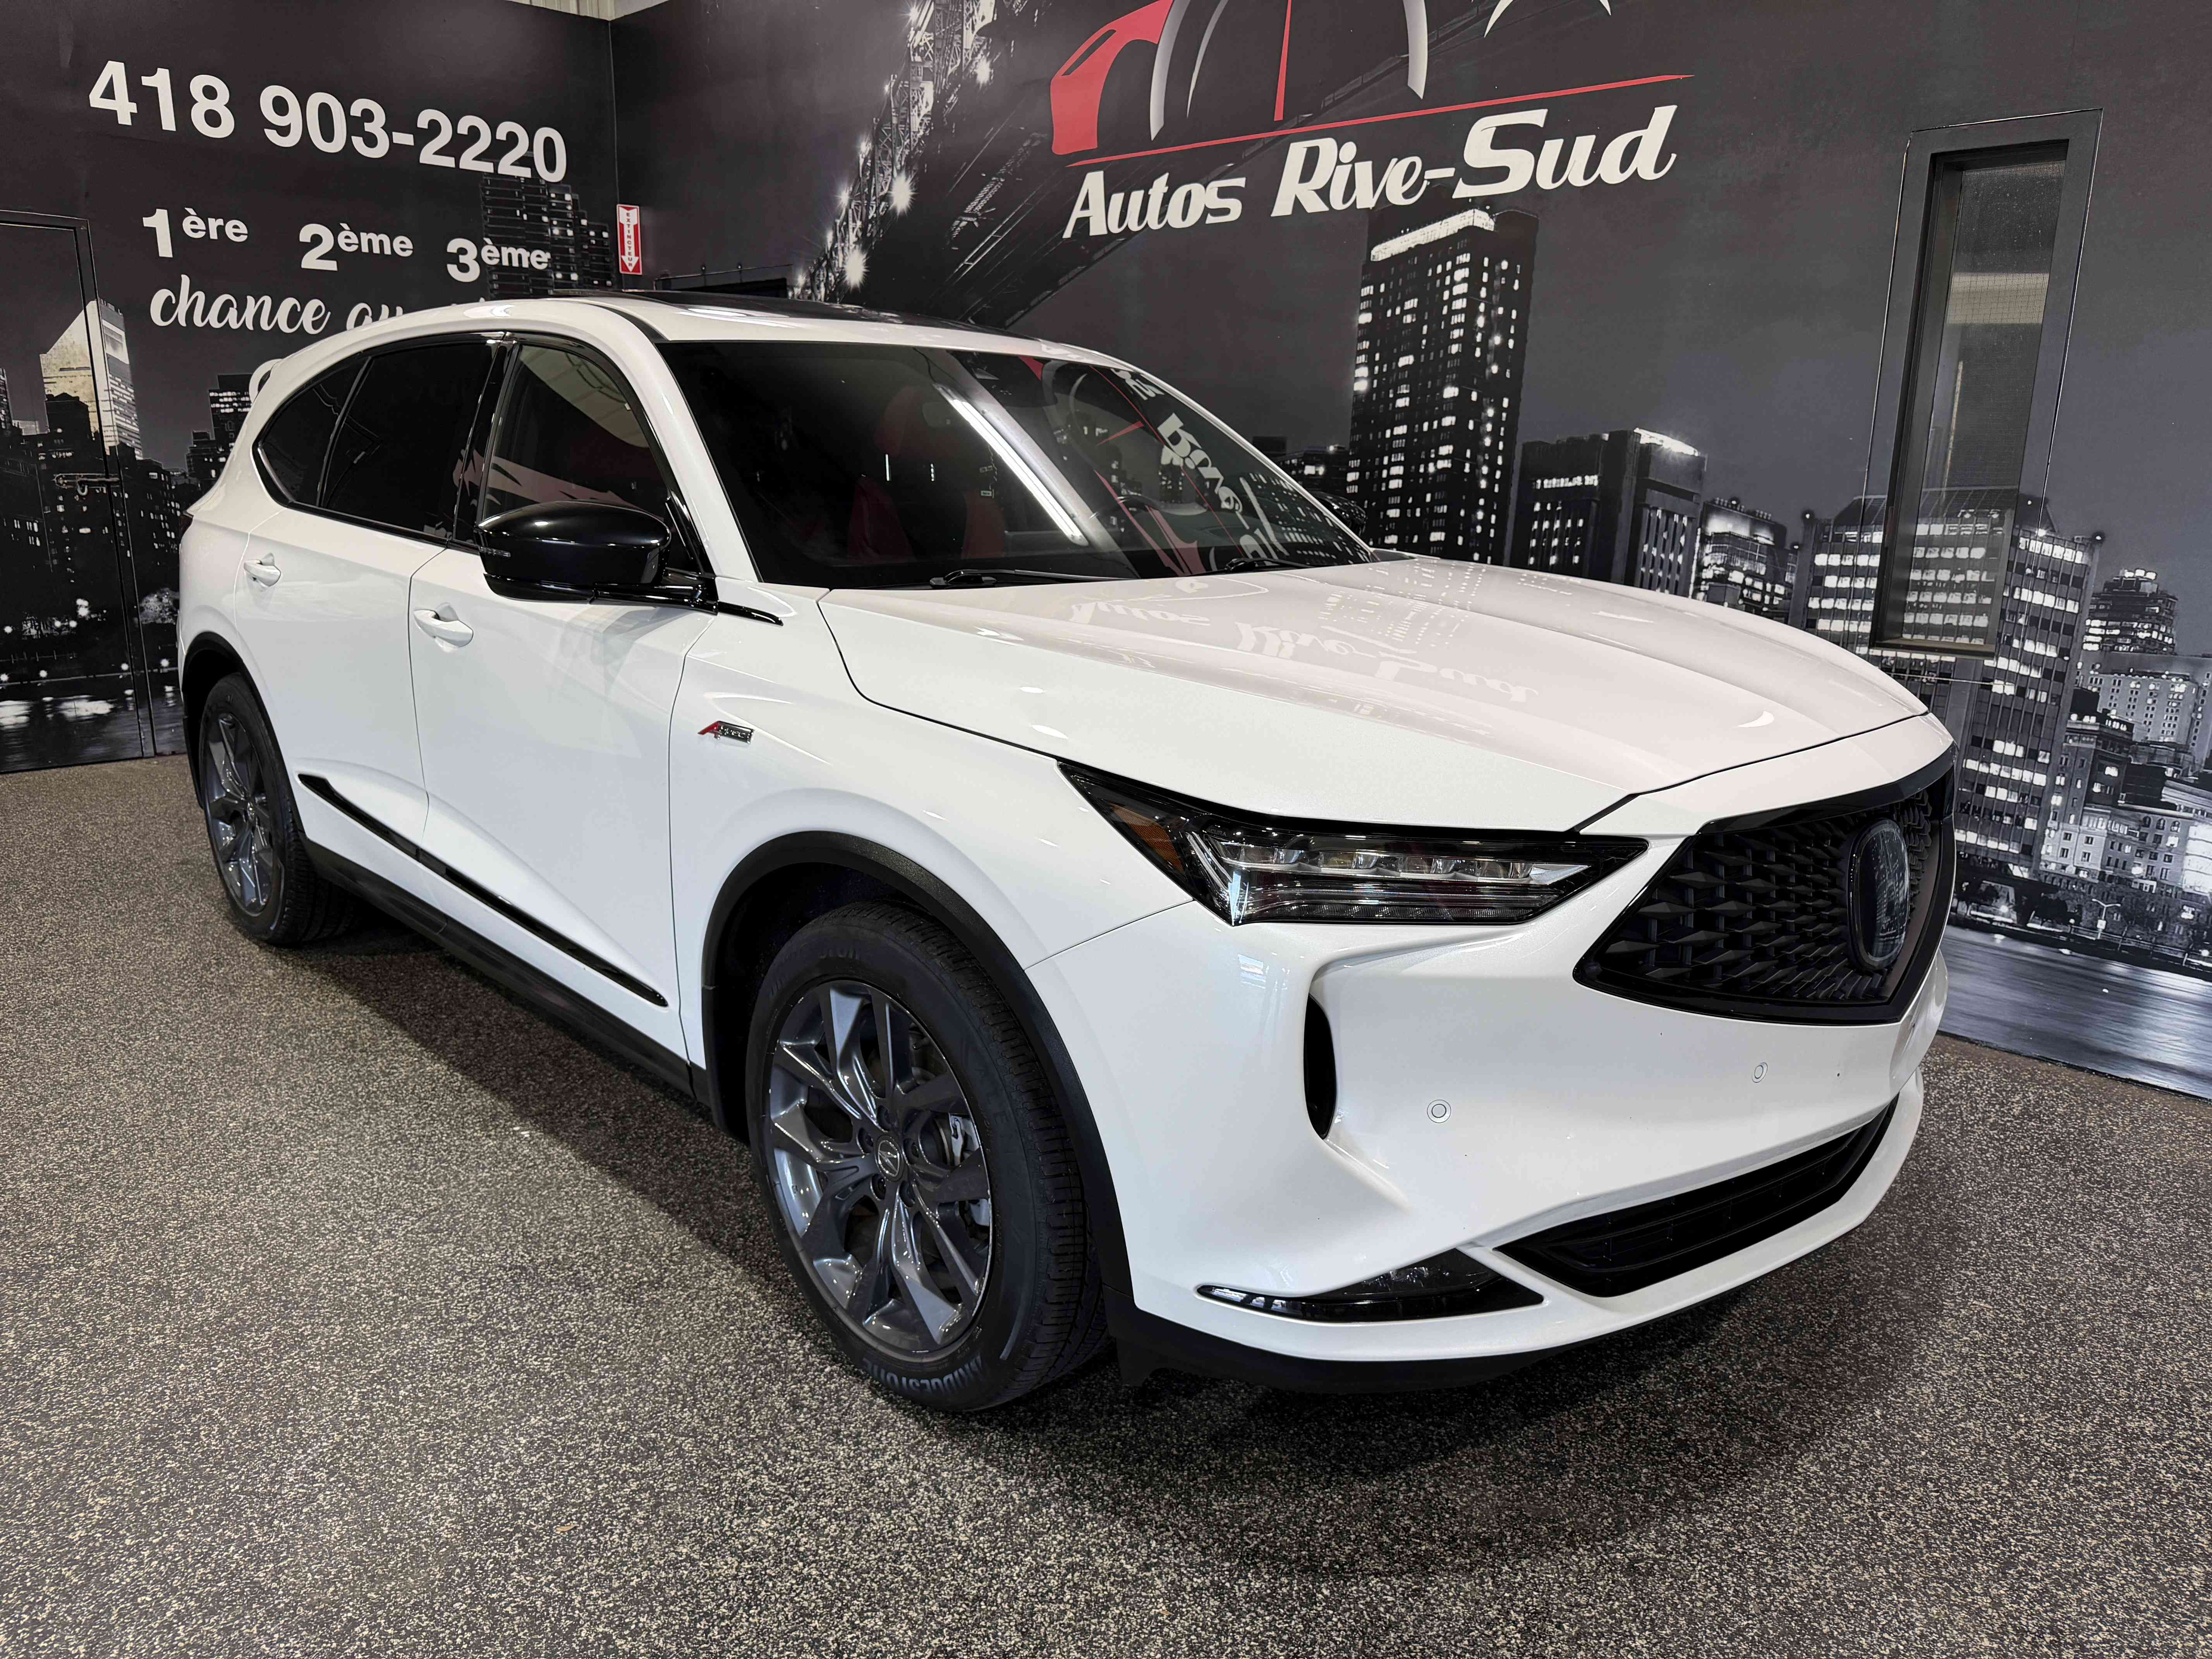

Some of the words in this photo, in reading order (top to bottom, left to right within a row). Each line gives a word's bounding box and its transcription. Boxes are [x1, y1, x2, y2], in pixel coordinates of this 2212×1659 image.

[89, 60, 235, 138] 418
[260, 85, 567, 182] 903-2220
[1062, 170, 1246, 239] Autos
[1271, 105, 1678, 217] Rive-Sud
[143, 207, 248, 258] 1ère
[299, 223, 413, 271] 2ème
[447, 238, 551, 282] 3ème
[150, 274, 331, 334] chance
